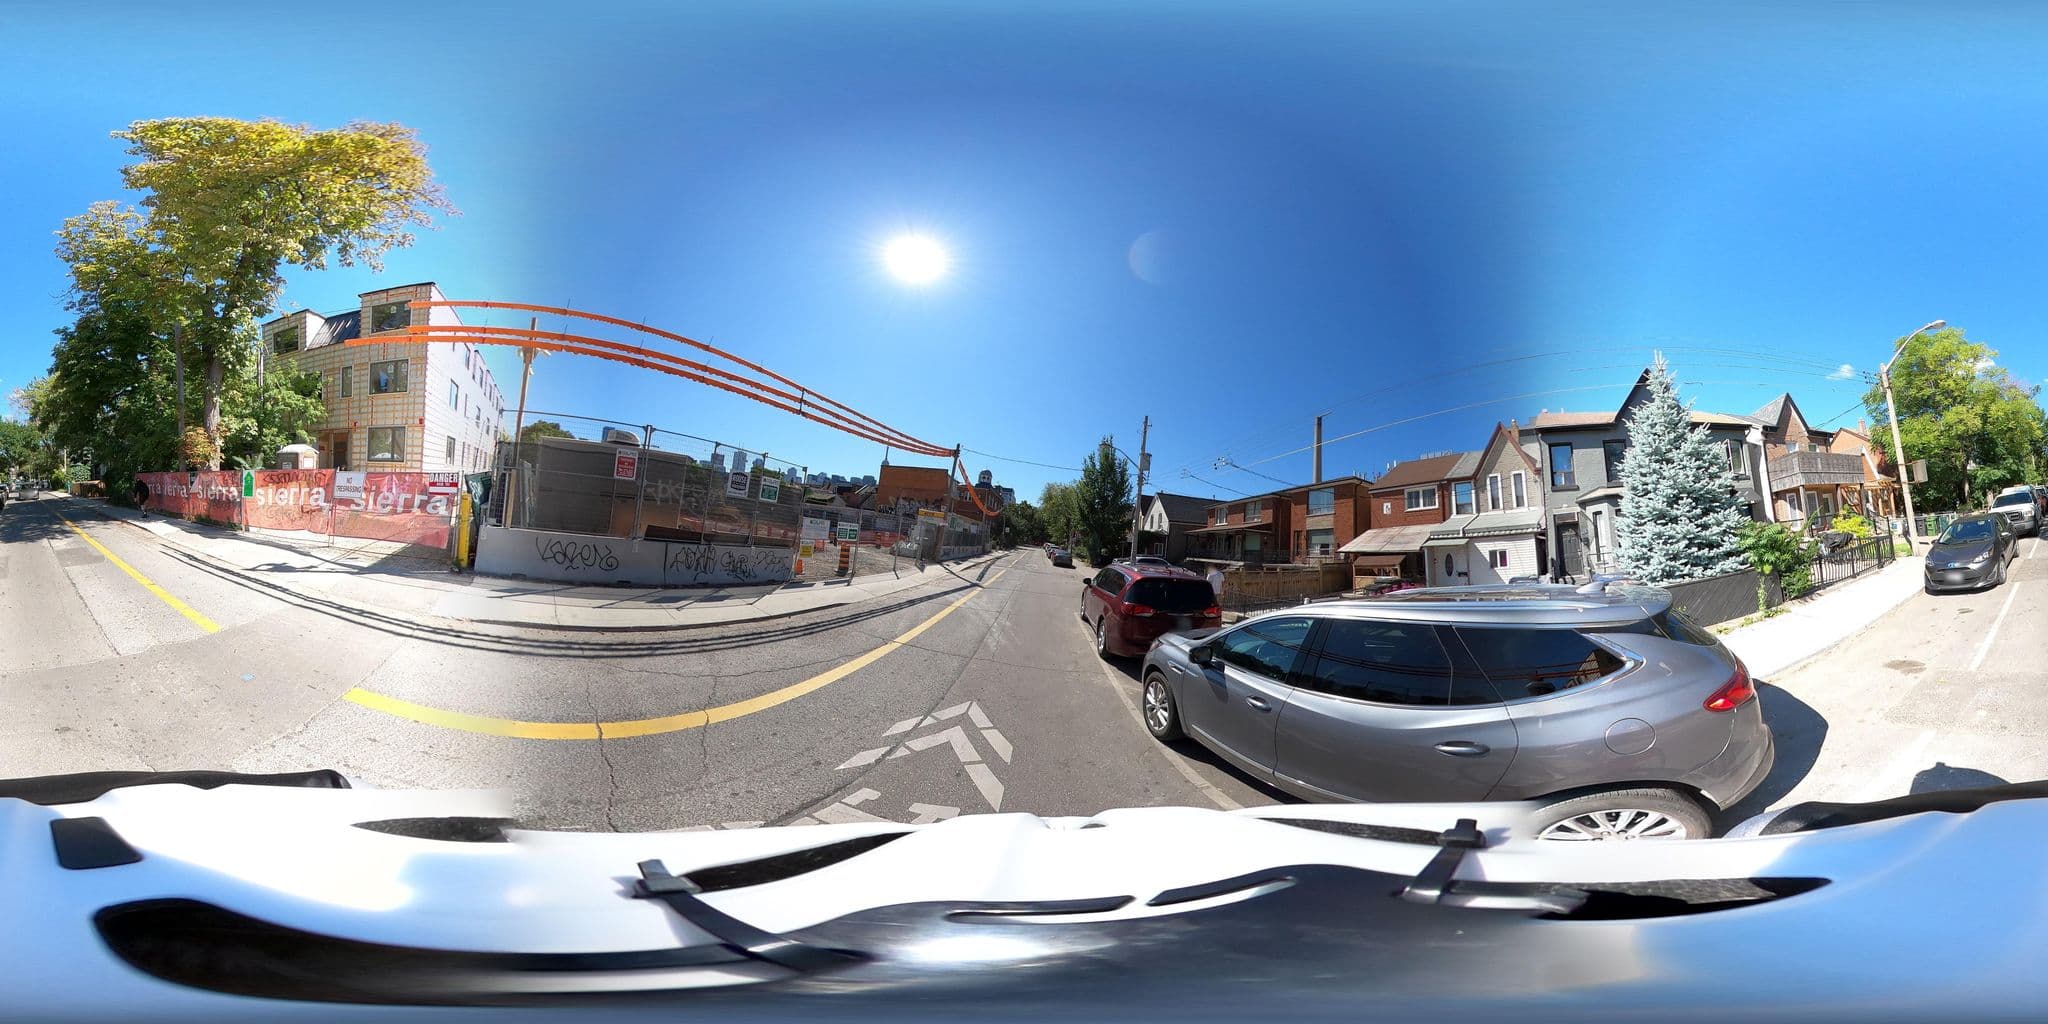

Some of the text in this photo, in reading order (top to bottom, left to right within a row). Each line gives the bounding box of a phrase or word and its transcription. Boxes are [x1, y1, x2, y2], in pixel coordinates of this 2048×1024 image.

[430, 473, 458, 483] DANGER
[197, 486, 240, 502] sierra
[256, 484, 326, 507] sierra
[350, 485, 449, 515] sierra
